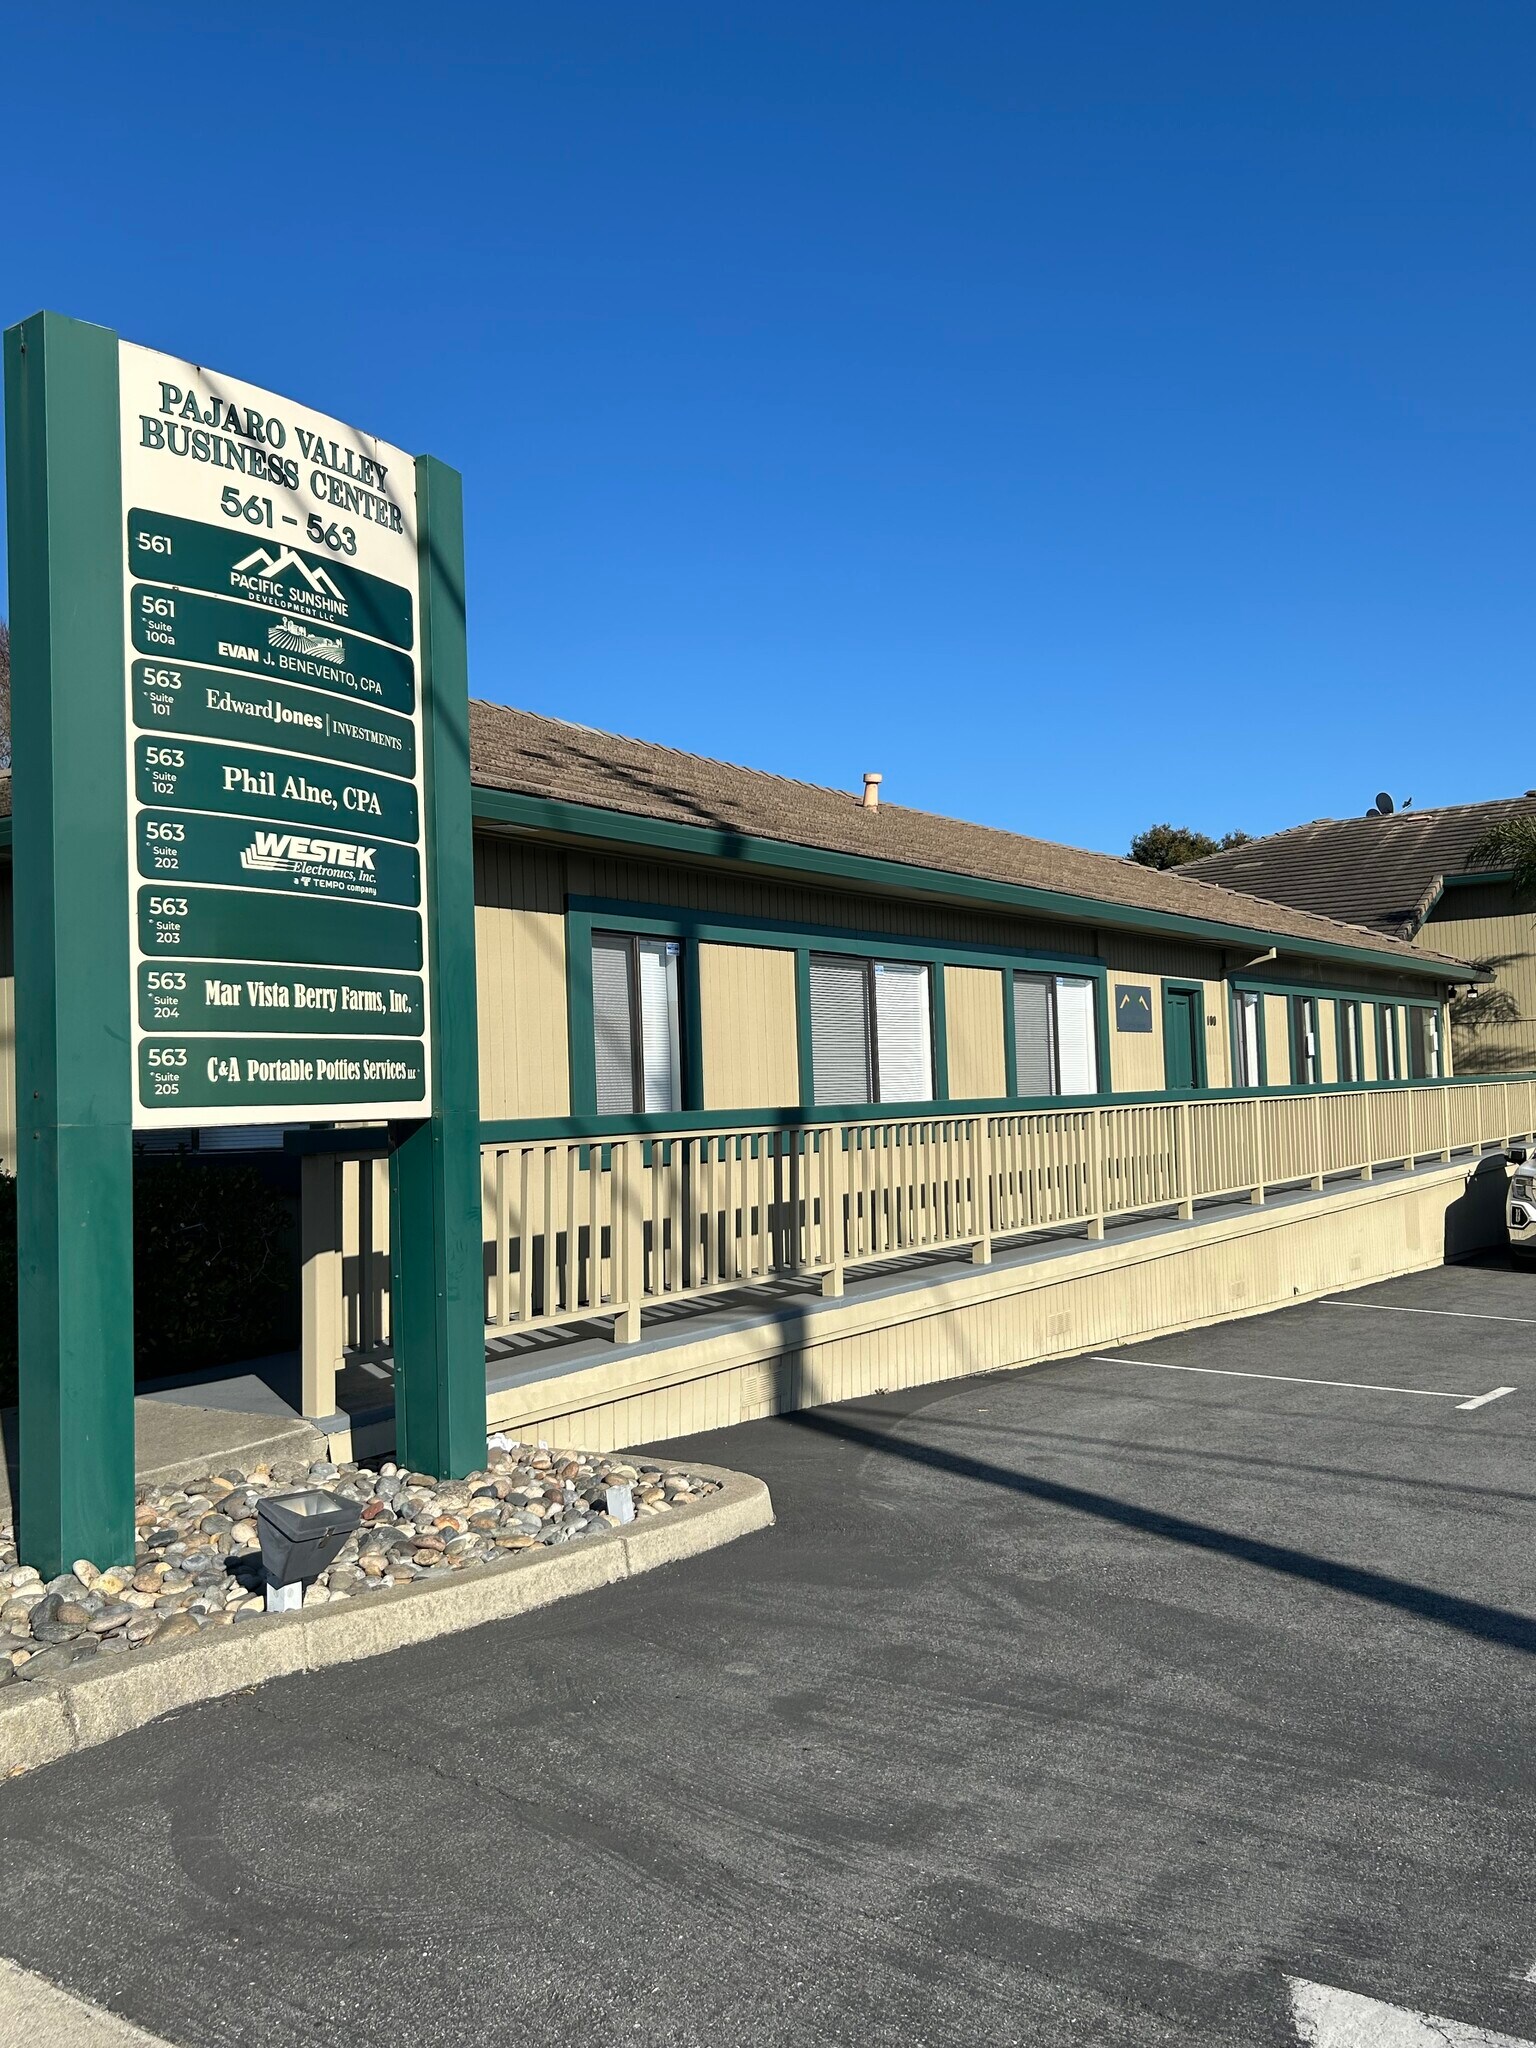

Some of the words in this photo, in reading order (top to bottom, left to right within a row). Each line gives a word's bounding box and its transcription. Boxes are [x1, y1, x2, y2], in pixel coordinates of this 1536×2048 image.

[158, 381, 286, 449] PAJARO
[295, 427, 388, 494] VALLEY
[139, 414, 299, 491] BUSINESS
[310, 470, 403, 535] CENTER
[221, 486, 273, 528] 561
[306, 512, 357, 556] 563
[138, 532, 172, 555] 561
[230, 571, 284, 597] PACIFIC
[289, 587, 349, 617] SUNSHINE
[141, 595, 175, 618] 561
[248, 592, 317, 616] DEVELOPMENT
[319, 611, 335, 622] LLC
[148, 620, 173, 632] Suite
[145, 630, 176, 646] 100a
[143, 667, 182, 690] 563
[218, 641, 259, 663] EVAN
[263, 652, 275, 666] J.
[279, 656, 358, 690] BENEVENTO,
[360, 677, 383, 696] CPA
[150, 692, 175, 704] Suite
[151, 703, 171, 716] 101
[332, 720, 402, 751] INVESTMENTS
[146, 746, 185, 768] 563
[153, 771, 177, 782] Suite
[152, 782, 174, 795] 102
[222, 765, 276, 796] Phil
[282, 775, 338, 811] Alne,
[342, 786, 382, 816] CPA
[146, 821, 185, 842] 563
[153, 846, 178, 856] Suite
[254, 831, 377, 871] WESTEK
[154, 857, 179, 869] 202
[293, 861, 356, 881] Electronics,
[358, 869, 377, 884] Inc.
[314, 879, 345, 890] TEMPO
[346, 883, 377, 896] company
[149, 896, 189, 916] 563
[156, 921, 181, 931] Suite
[156, 932, 180, 944] 203
[147, 971, 187, 990] 563
[154, 996, 179, 1005] Suite
[204, 979, 242, 1006] Mar
[246, 981, 290, 1008] Vista
[293, 983, 338, 1013] Berry
[341, 985, 387, 1015] Farms,
[389, 989, 412, 1014] Inc.
[153, 1007, 180, 1018] 204
[147, 1048, 188, 1067] 563
[155, 1072, 180, 1082] Suite
[207, 1056, 241, 1083] C&A
[247, 1059, 313, 1082] Portable
[316, 1059, 360, 1081] Potties
[363, 1059, 406, 1080] Services
[154, 1084, 180, 1095] 205
